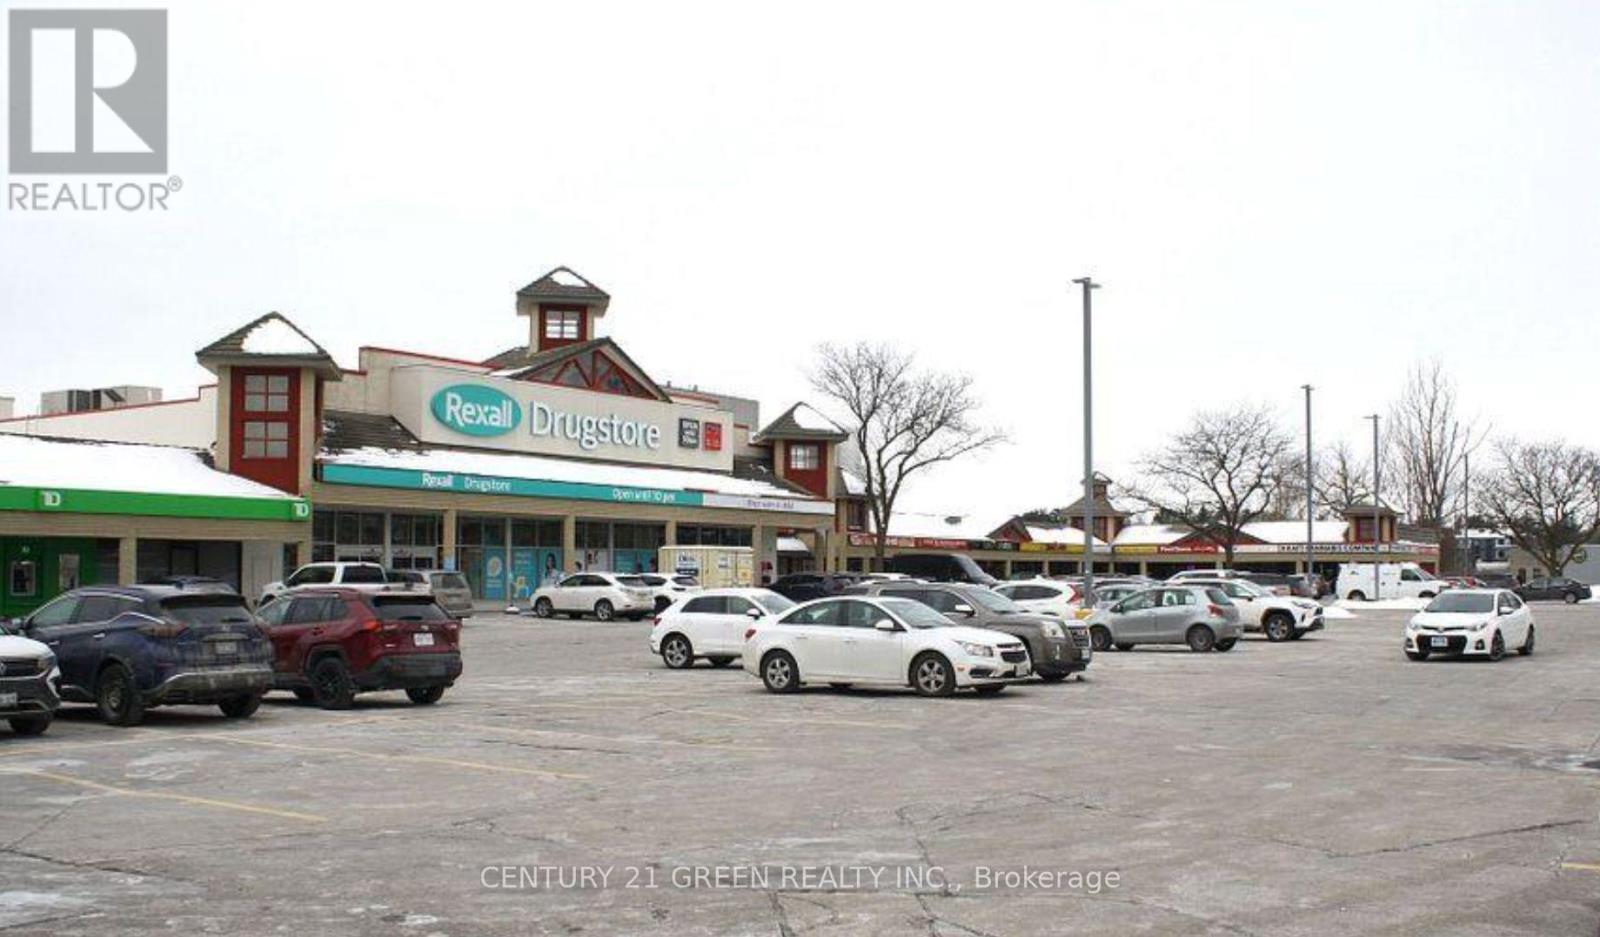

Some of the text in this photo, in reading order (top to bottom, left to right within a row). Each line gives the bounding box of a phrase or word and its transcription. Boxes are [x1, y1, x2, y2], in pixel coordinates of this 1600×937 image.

[445, 392, 513, 428] Rexall
[531, 400, 661, 449] Drugstore
[422, 472, 512, 492] Rexall Drugstore
[41, 490, 61, 506] TD
[294, 502, 309, 516] TD
